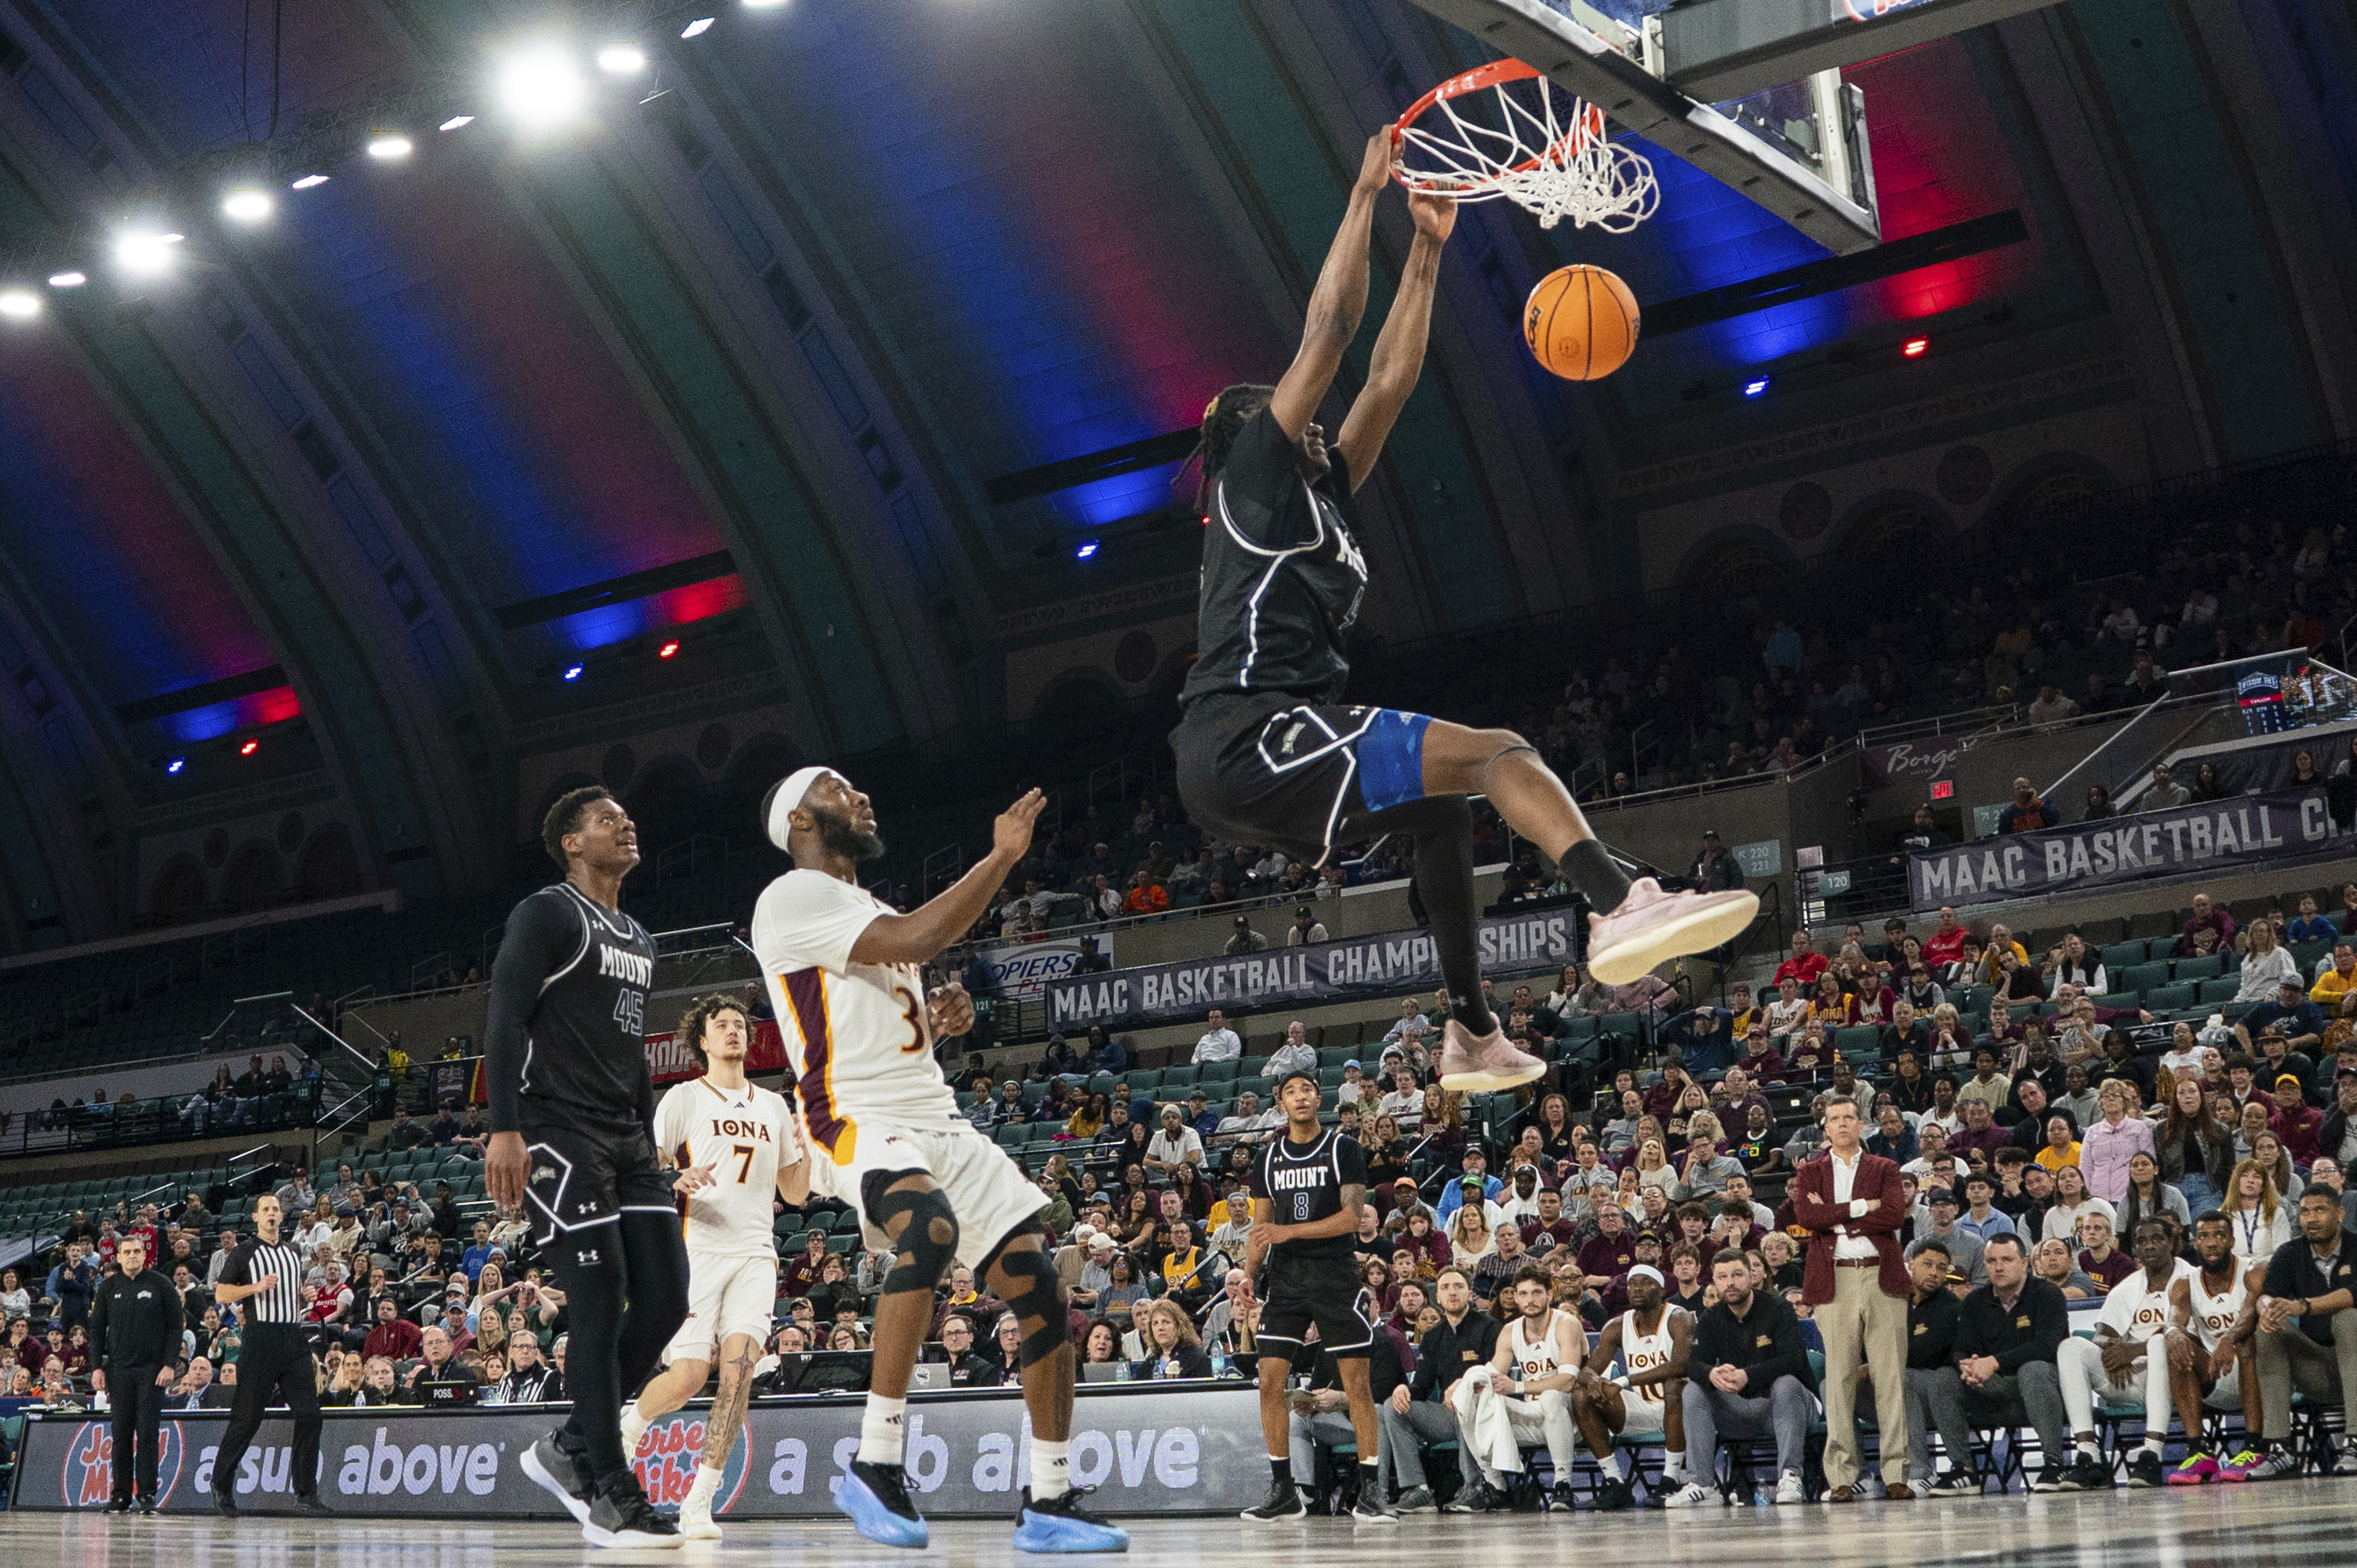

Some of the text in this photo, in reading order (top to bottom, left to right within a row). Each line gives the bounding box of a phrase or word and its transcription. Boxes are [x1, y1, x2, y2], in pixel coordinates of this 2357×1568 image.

[1750, 847, 1769, 859] 220
[1921, 845, 2025, 901] MAAC
[2044, 805, 2282, 883] BASKETBALL
[1827, 876, 1847, 889] 120
[599, 943, 653, 989] MOUNT
[992, 953, 1076, 981] OPIERS
[1054, 917, 1567, 1022] MAAC BASKETBALL CHAMPISHIPS
[613, 988, 643, 1036] 45
[894, 984, 925, 1054] 3
[975, 1000, 989, 1011] 121
[298, 1088, 309, 1097] 123
[379, 1078, 390, 1087] 122
[710, 1119, 772, 1143] IONA
[732, 1143, 755, 1185] 7
[1273, 1165, 1329, 1191] MOUNT
[1294, 1192, 1309, 1220] 8
[1627, 1350, 1670, 1368] IONA
[433, 1388, 453, 1398] POSS.
[236, 1445, 324, 1494] su
[769, 1438, 808, 1495] a
